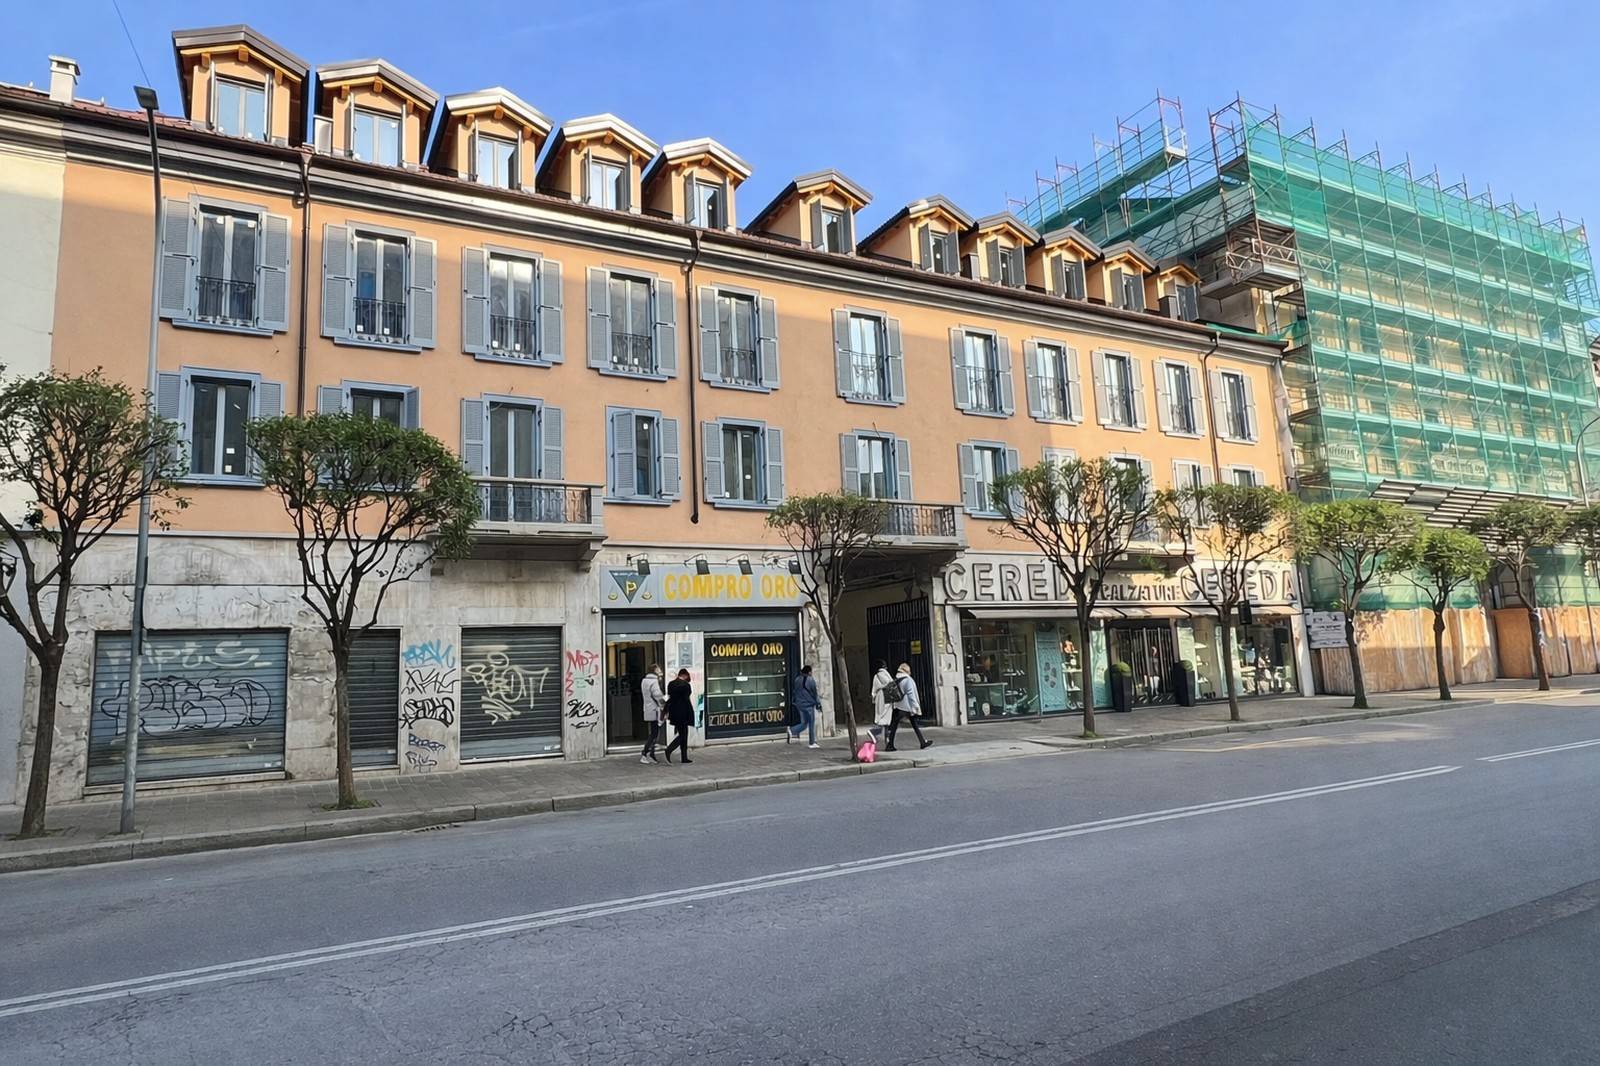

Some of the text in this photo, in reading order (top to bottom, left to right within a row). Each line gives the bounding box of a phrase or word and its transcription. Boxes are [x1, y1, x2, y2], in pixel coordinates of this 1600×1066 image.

[664, 573, 800, 601] COMPRO ORO
[944, 562, 1078, 601] CERED
[711, 643, 758, 657] COMPRO
